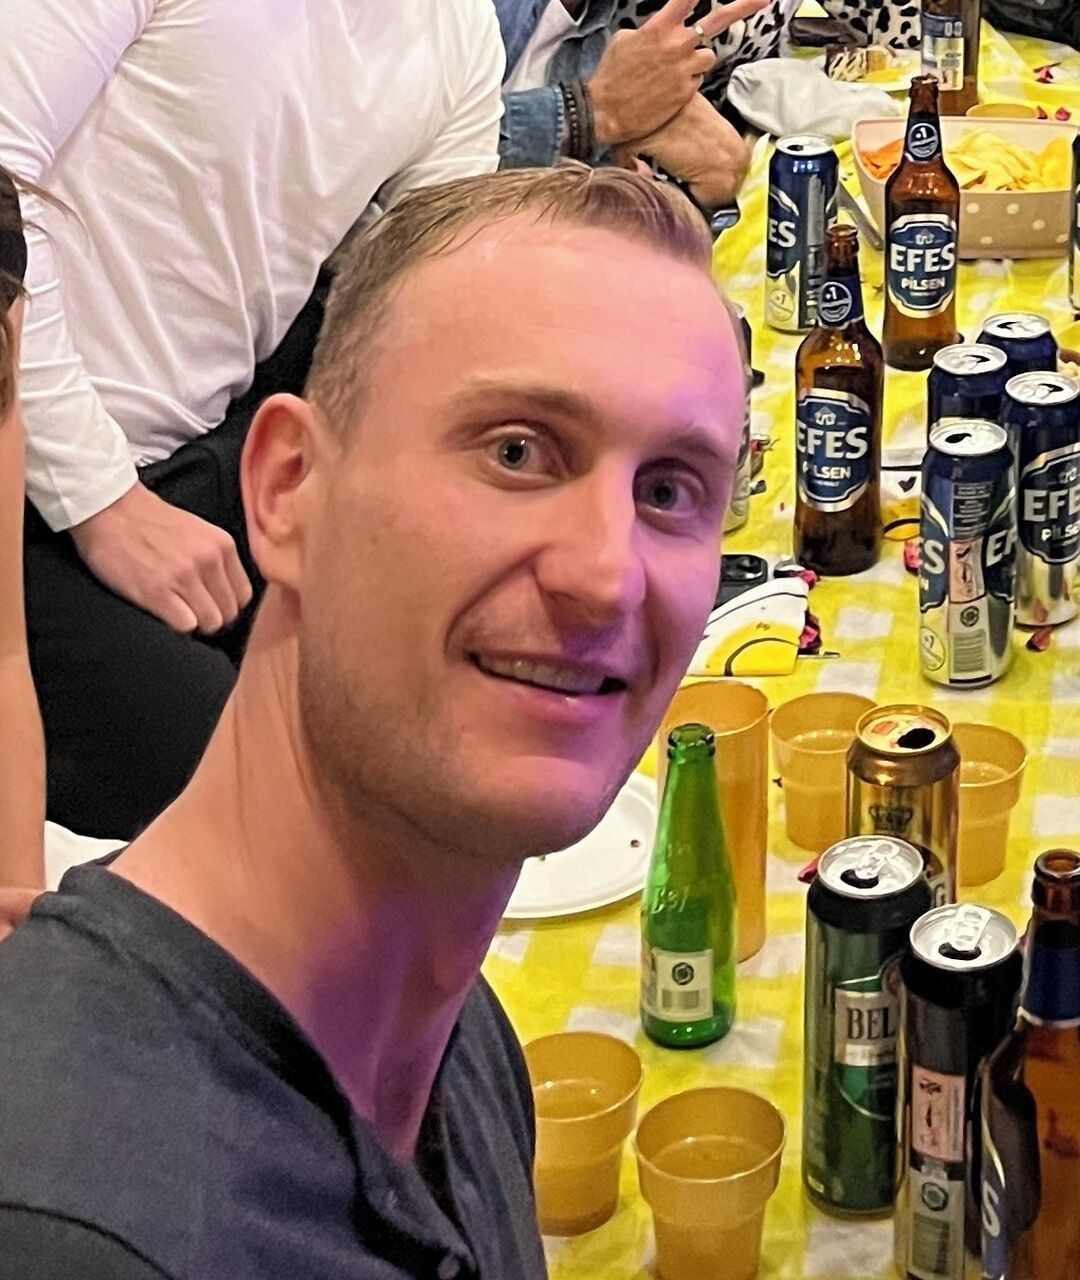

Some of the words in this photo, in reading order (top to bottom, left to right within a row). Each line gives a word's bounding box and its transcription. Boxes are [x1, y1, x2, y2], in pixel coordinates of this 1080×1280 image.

[768, 218, 797, 248] ES
[890, 242, 956, 272] EFES
[802, 460, 851, 479] PLSEN
[846, 1006, 897, 1040] BEL
